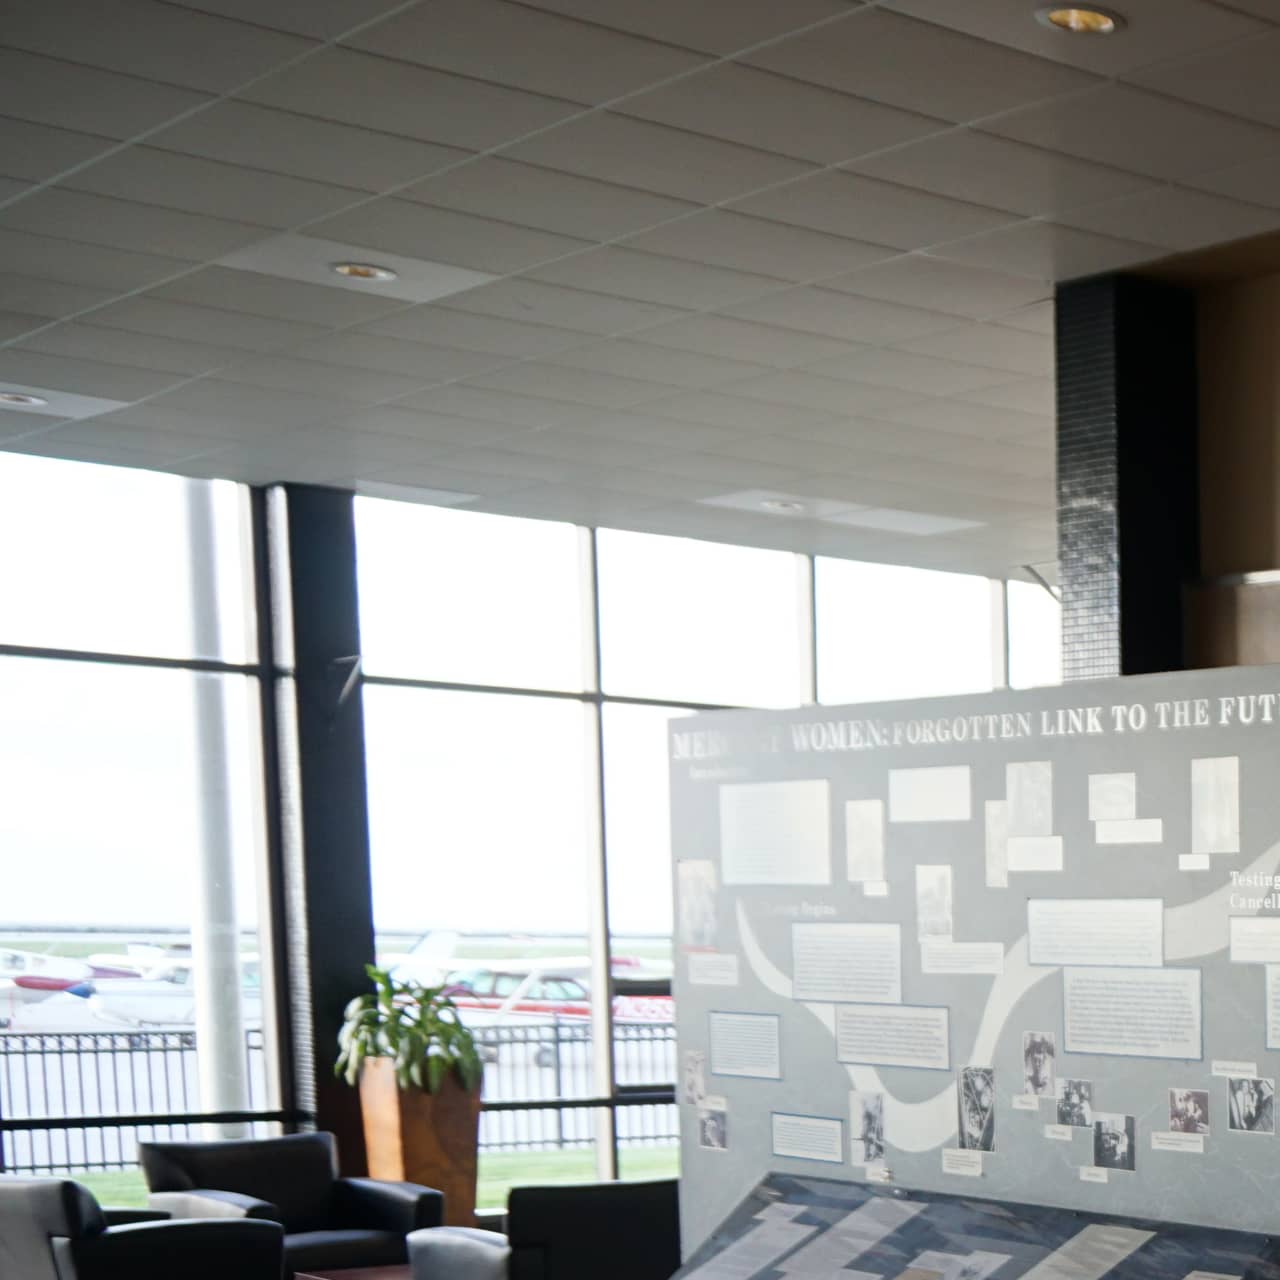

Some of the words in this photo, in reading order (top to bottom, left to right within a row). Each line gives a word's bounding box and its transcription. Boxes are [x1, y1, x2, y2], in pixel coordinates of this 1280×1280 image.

[791, 720, 889, 752] WOMEN:
[893, 712, 1032, 745] FORGOTTEN
[1040, 707, 1104, 736] LINK
[1112, 703, 1148, 732] TO
[1154, 699, 1209, 728] THE
